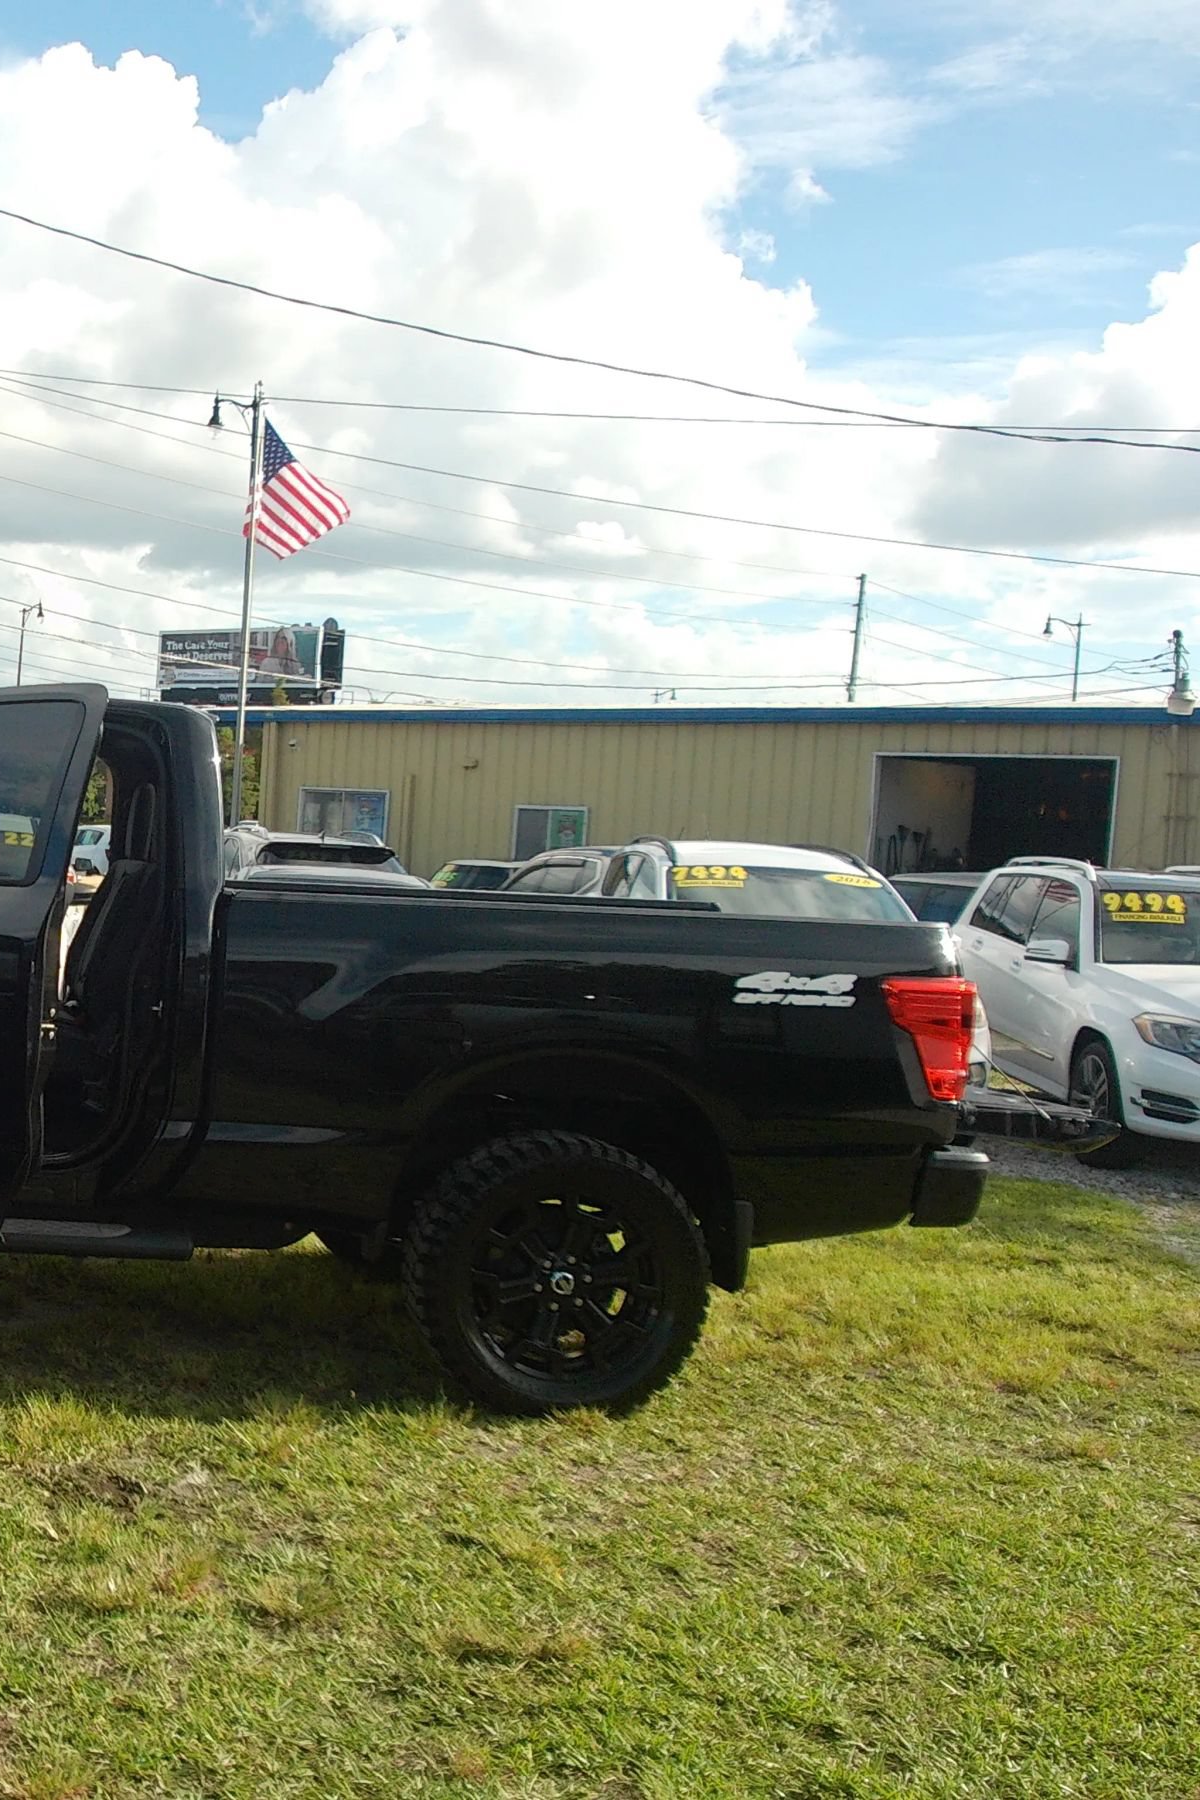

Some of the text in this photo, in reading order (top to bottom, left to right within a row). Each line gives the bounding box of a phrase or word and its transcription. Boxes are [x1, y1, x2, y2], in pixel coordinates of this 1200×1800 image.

[166, 640, 230, 650] The Care Your
[192, 651, 233, 661] Deserves
[672, 866, 748, 881] 7494
[1103, 892, 1186, 913] 9494
